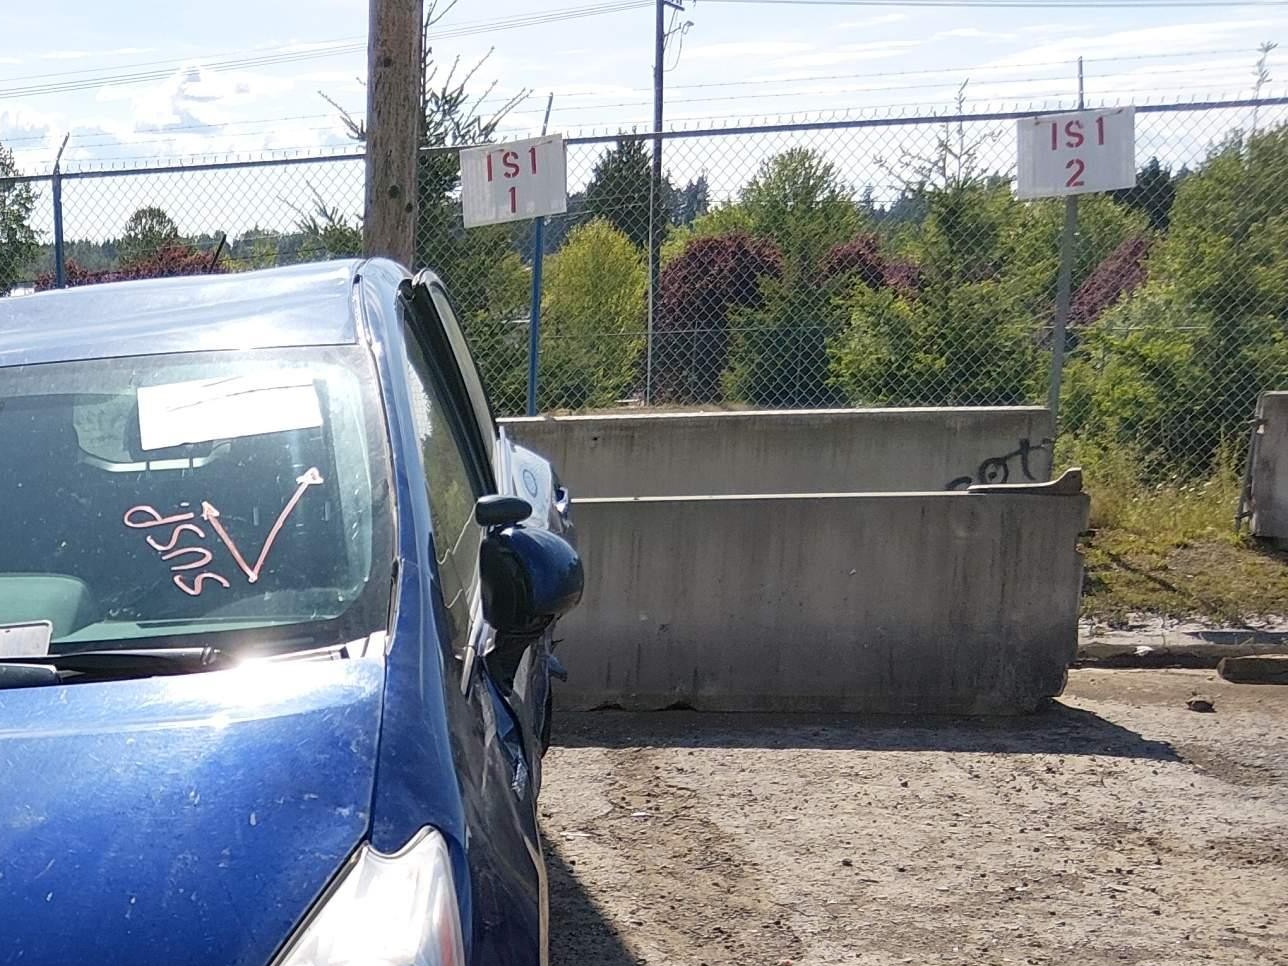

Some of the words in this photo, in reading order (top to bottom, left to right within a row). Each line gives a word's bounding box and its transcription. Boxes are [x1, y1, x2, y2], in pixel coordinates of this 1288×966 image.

[1065, 158, 1085, 188] 2
[508, 186, 517, 214] 1
[123, 505, 230, 596] SUSP
